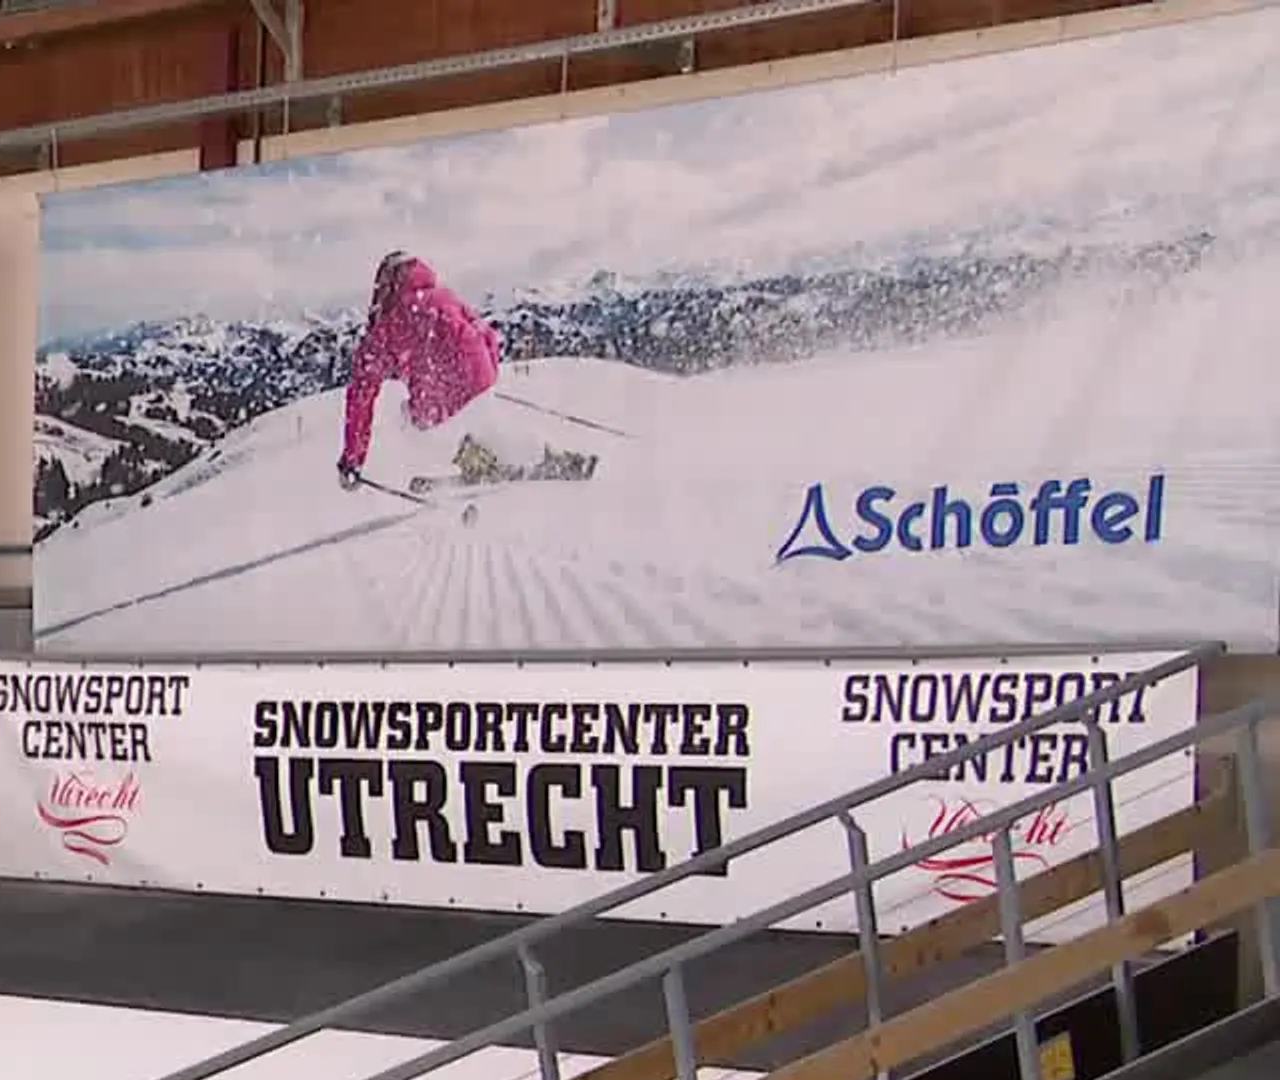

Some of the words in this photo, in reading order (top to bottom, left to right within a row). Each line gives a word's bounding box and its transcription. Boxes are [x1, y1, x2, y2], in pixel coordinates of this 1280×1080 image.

[851, 474, 1164, 553] Schöffel
[841, 671, 1158, 724] SNOWSPORT
[21, 720, 153, 763] CENTER
[253, 700, 751, 757] SNOWSPORTCENTER
[890, 732, 1094, 784] CENTER
[253, 755, 749, 877] UTRECHT
